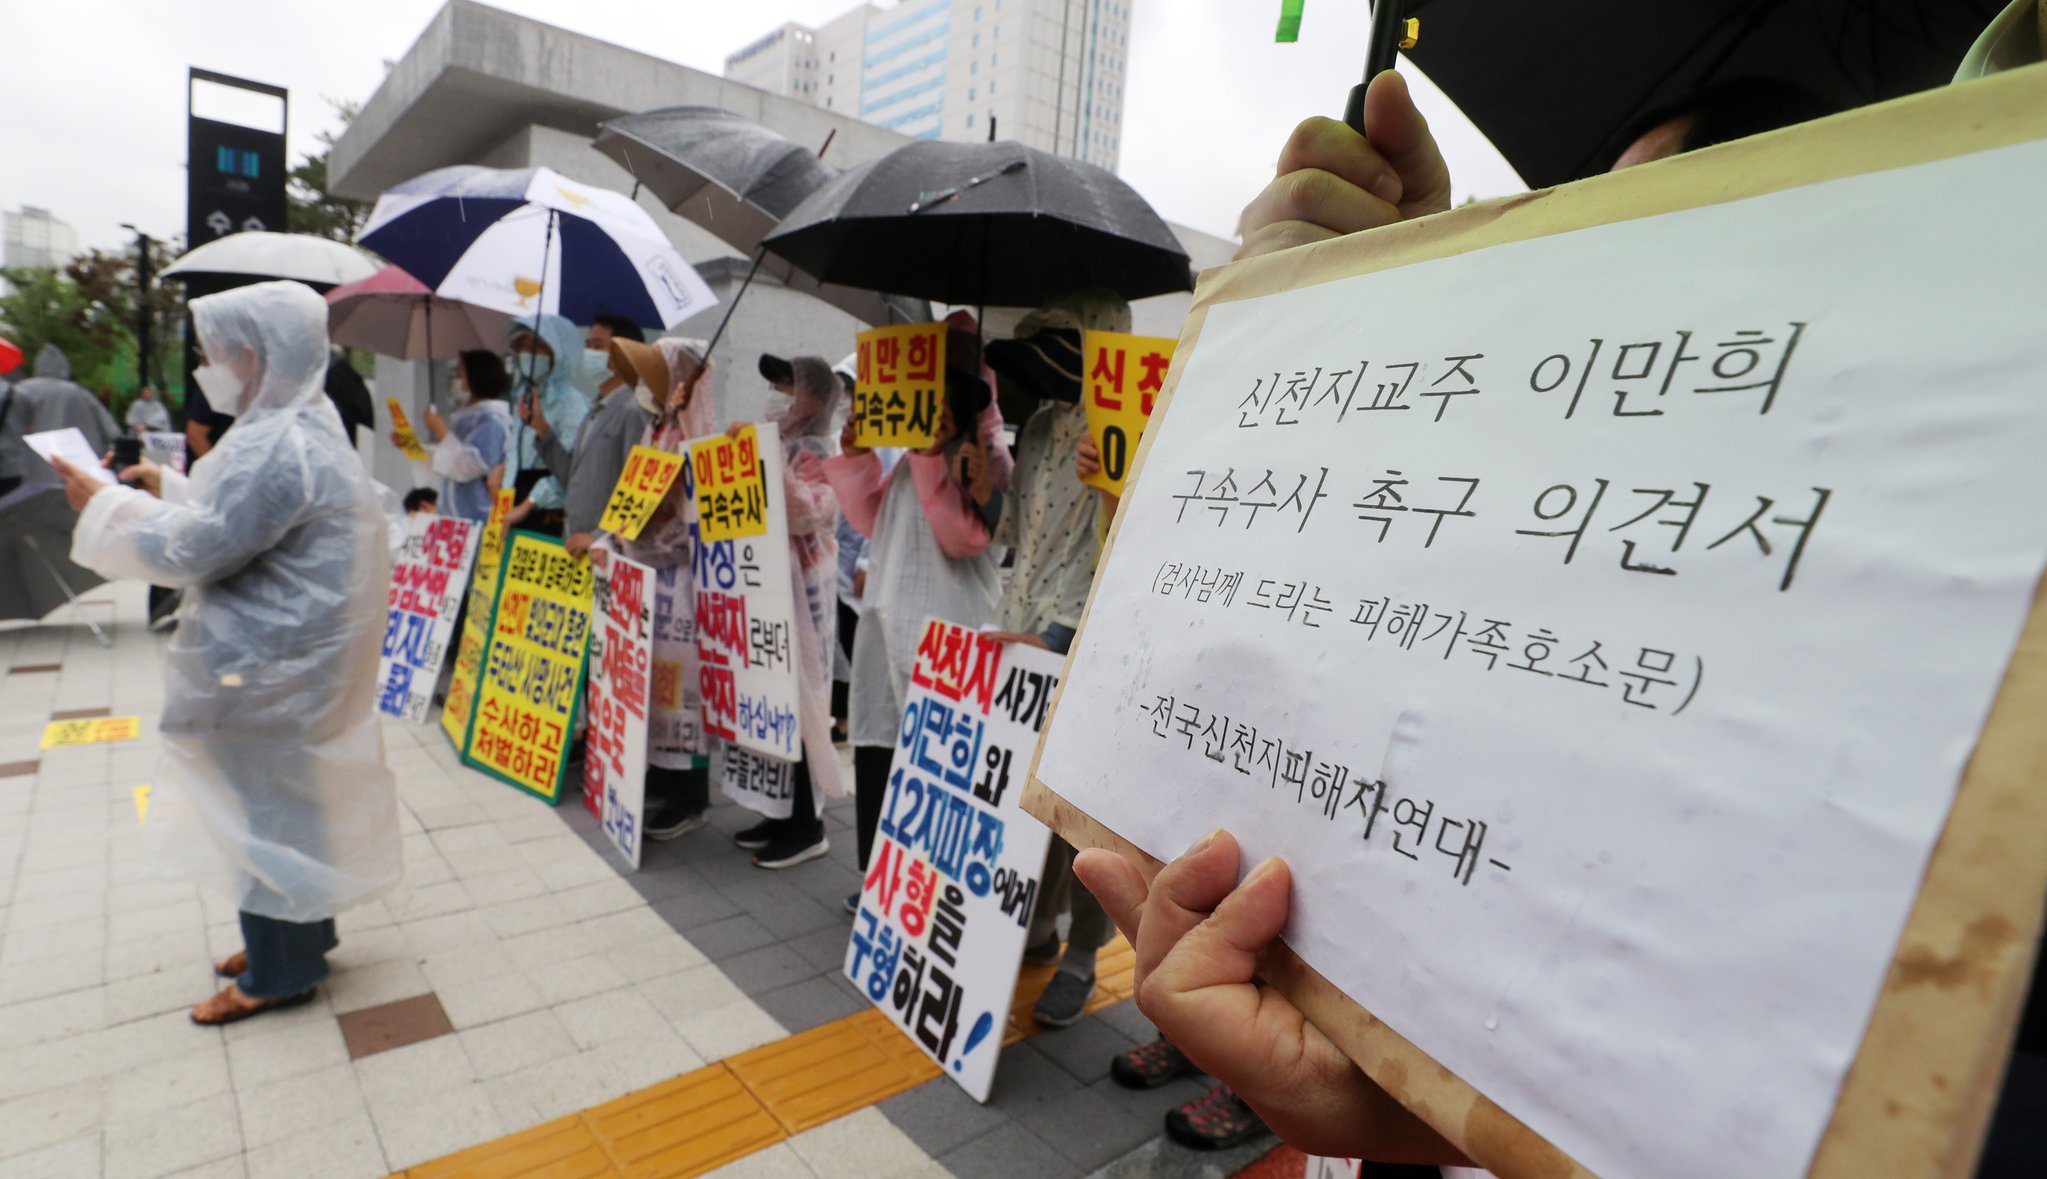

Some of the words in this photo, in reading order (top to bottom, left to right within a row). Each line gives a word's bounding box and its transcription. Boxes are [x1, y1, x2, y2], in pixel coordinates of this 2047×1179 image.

[858, 332, 938, 385] 이만희
[1238, 353, 1485, 428] 신천지교주
[1529, 321, 1809, 420] 이만희
[697, 435, 757, 487] 이만희
[855, 389, 937, 440] 구속수사
[624, 453, 678, 495] 이만희
[700, 484, 762, 532] 구속수사
[1173, 466, 1329, 533] 구속수사
[1352, 469, 1481, 549] 촉구
[1515, 477, 1833, 592] 의견서
[911, 620, 1004, 716] 신천지
[995, 666, 1059, 733] 사기
[1151, 560, 1244, 609] (검사님께
[1246, 577, 1335, 629] 드리는
[1349, 595, 1705, 716] 피해가족호소문)
[475, 725, 557, 789] 처벌하라
[481, 696, 563, 755] 수사하고
[901, 696, 1013, 808] 이만희와
[880, 767, 1037, 928] 12지파장에게
[863, 839, 967, 969] 사형을
[850, 906, 993, 1073] 구형하라!
